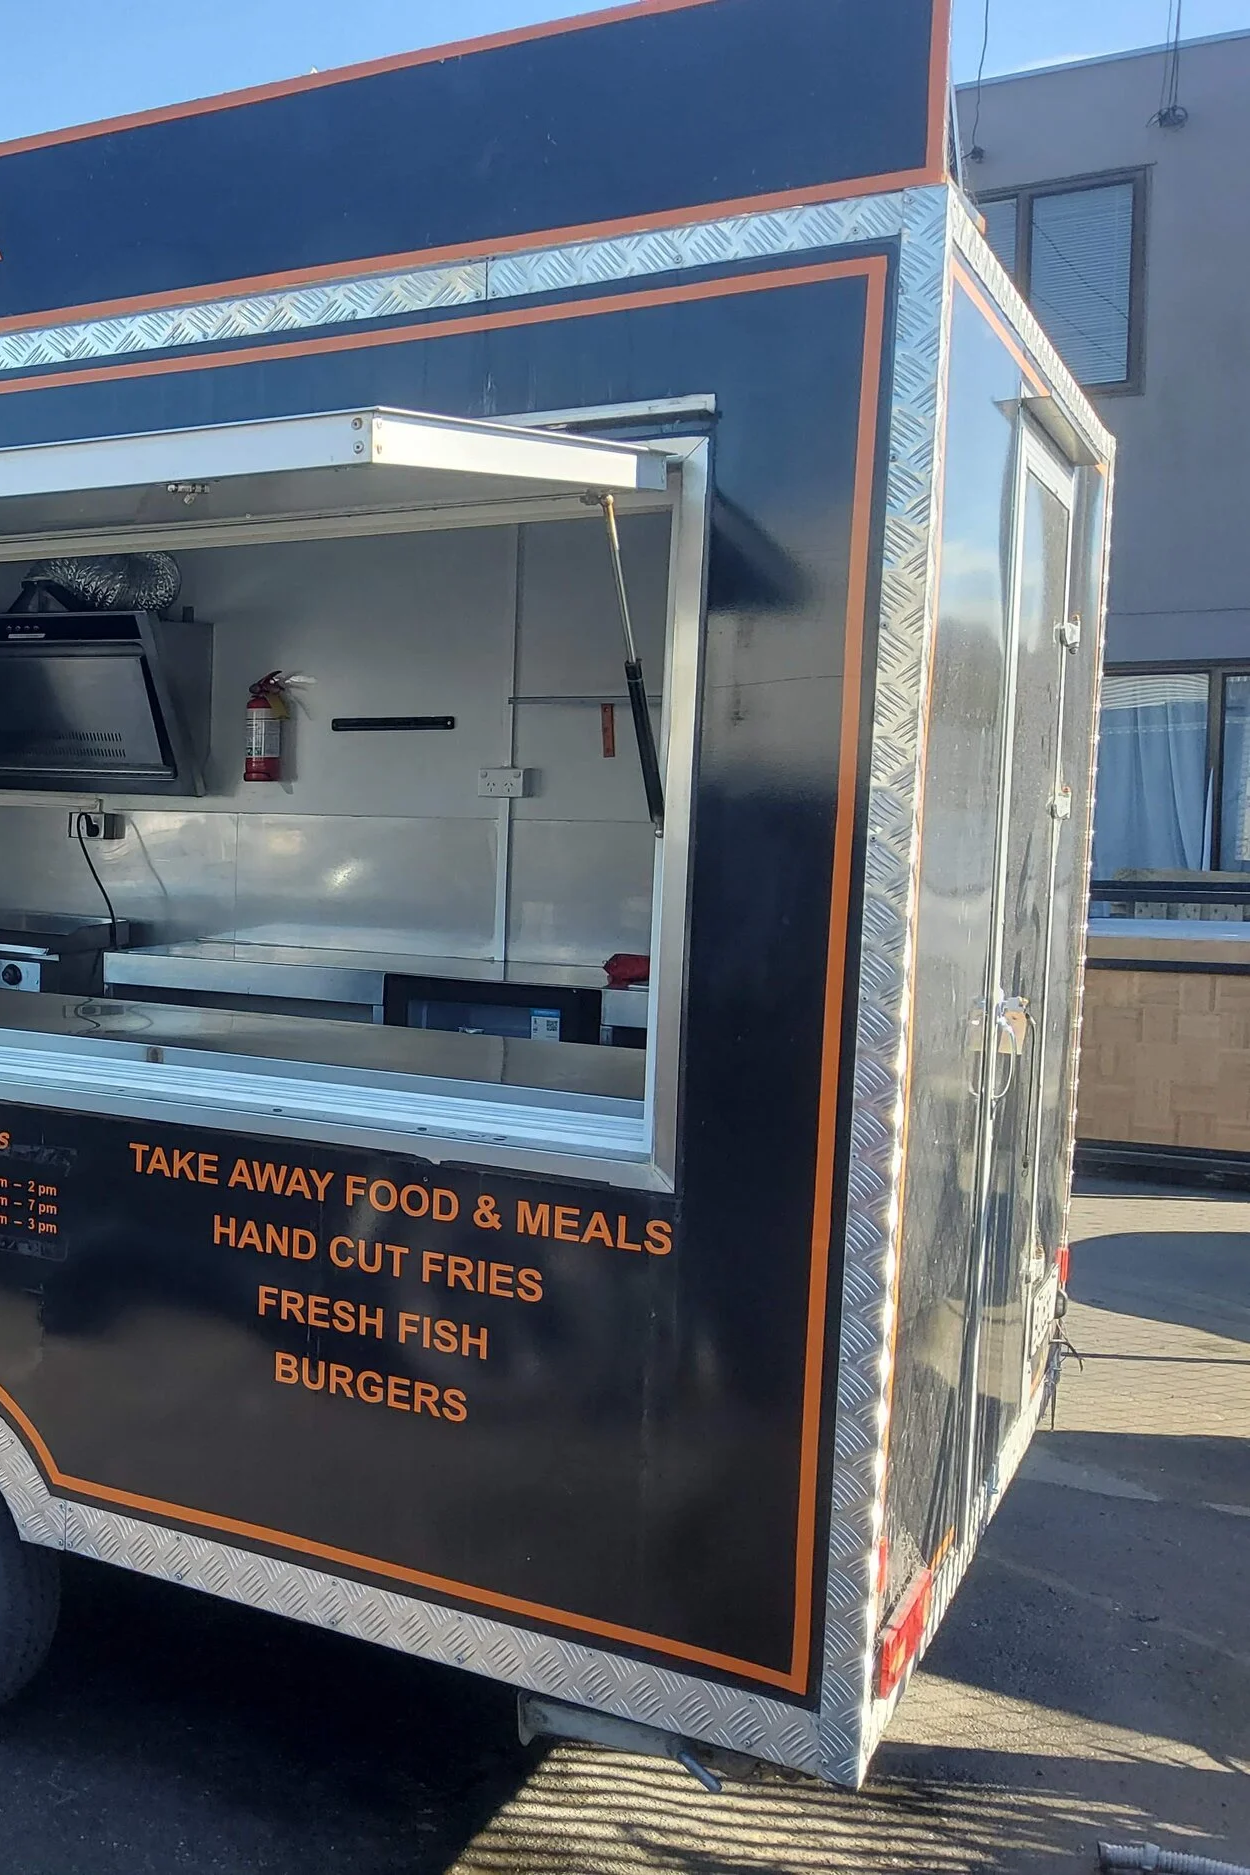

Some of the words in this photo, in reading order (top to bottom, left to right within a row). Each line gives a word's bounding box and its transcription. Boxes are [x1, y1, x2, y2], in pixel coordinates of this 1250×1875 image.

[28, 1181, 36, 1193] 2
[38, 1184, 57, 1197] pm
[28, 1199, 36, 1211] 7
[38, 1203, 57, 1216] pm
[129, 1142, 219, 1185] TAKE
[228, 1158, 335, 1202] AWAY
[345, 1175, 459, 1222] FOOD
[472, 1194, 503, 1231] &
[516, 1200, 673, 1256] MEALS
[28, 1218, 36, 1230] 3
[38, 1222, 57, 1235] pm
[213, 1214, 317, 1261] HAND
[329, 1235, 410, 1278] CUT
[422, 1250, 544, 1303] FRIES
[258, 1285, 384, 1340] FRESH
[398, 1311, 489, 1360] FISH
[274, 1351, 469, 1423] BURGERS
